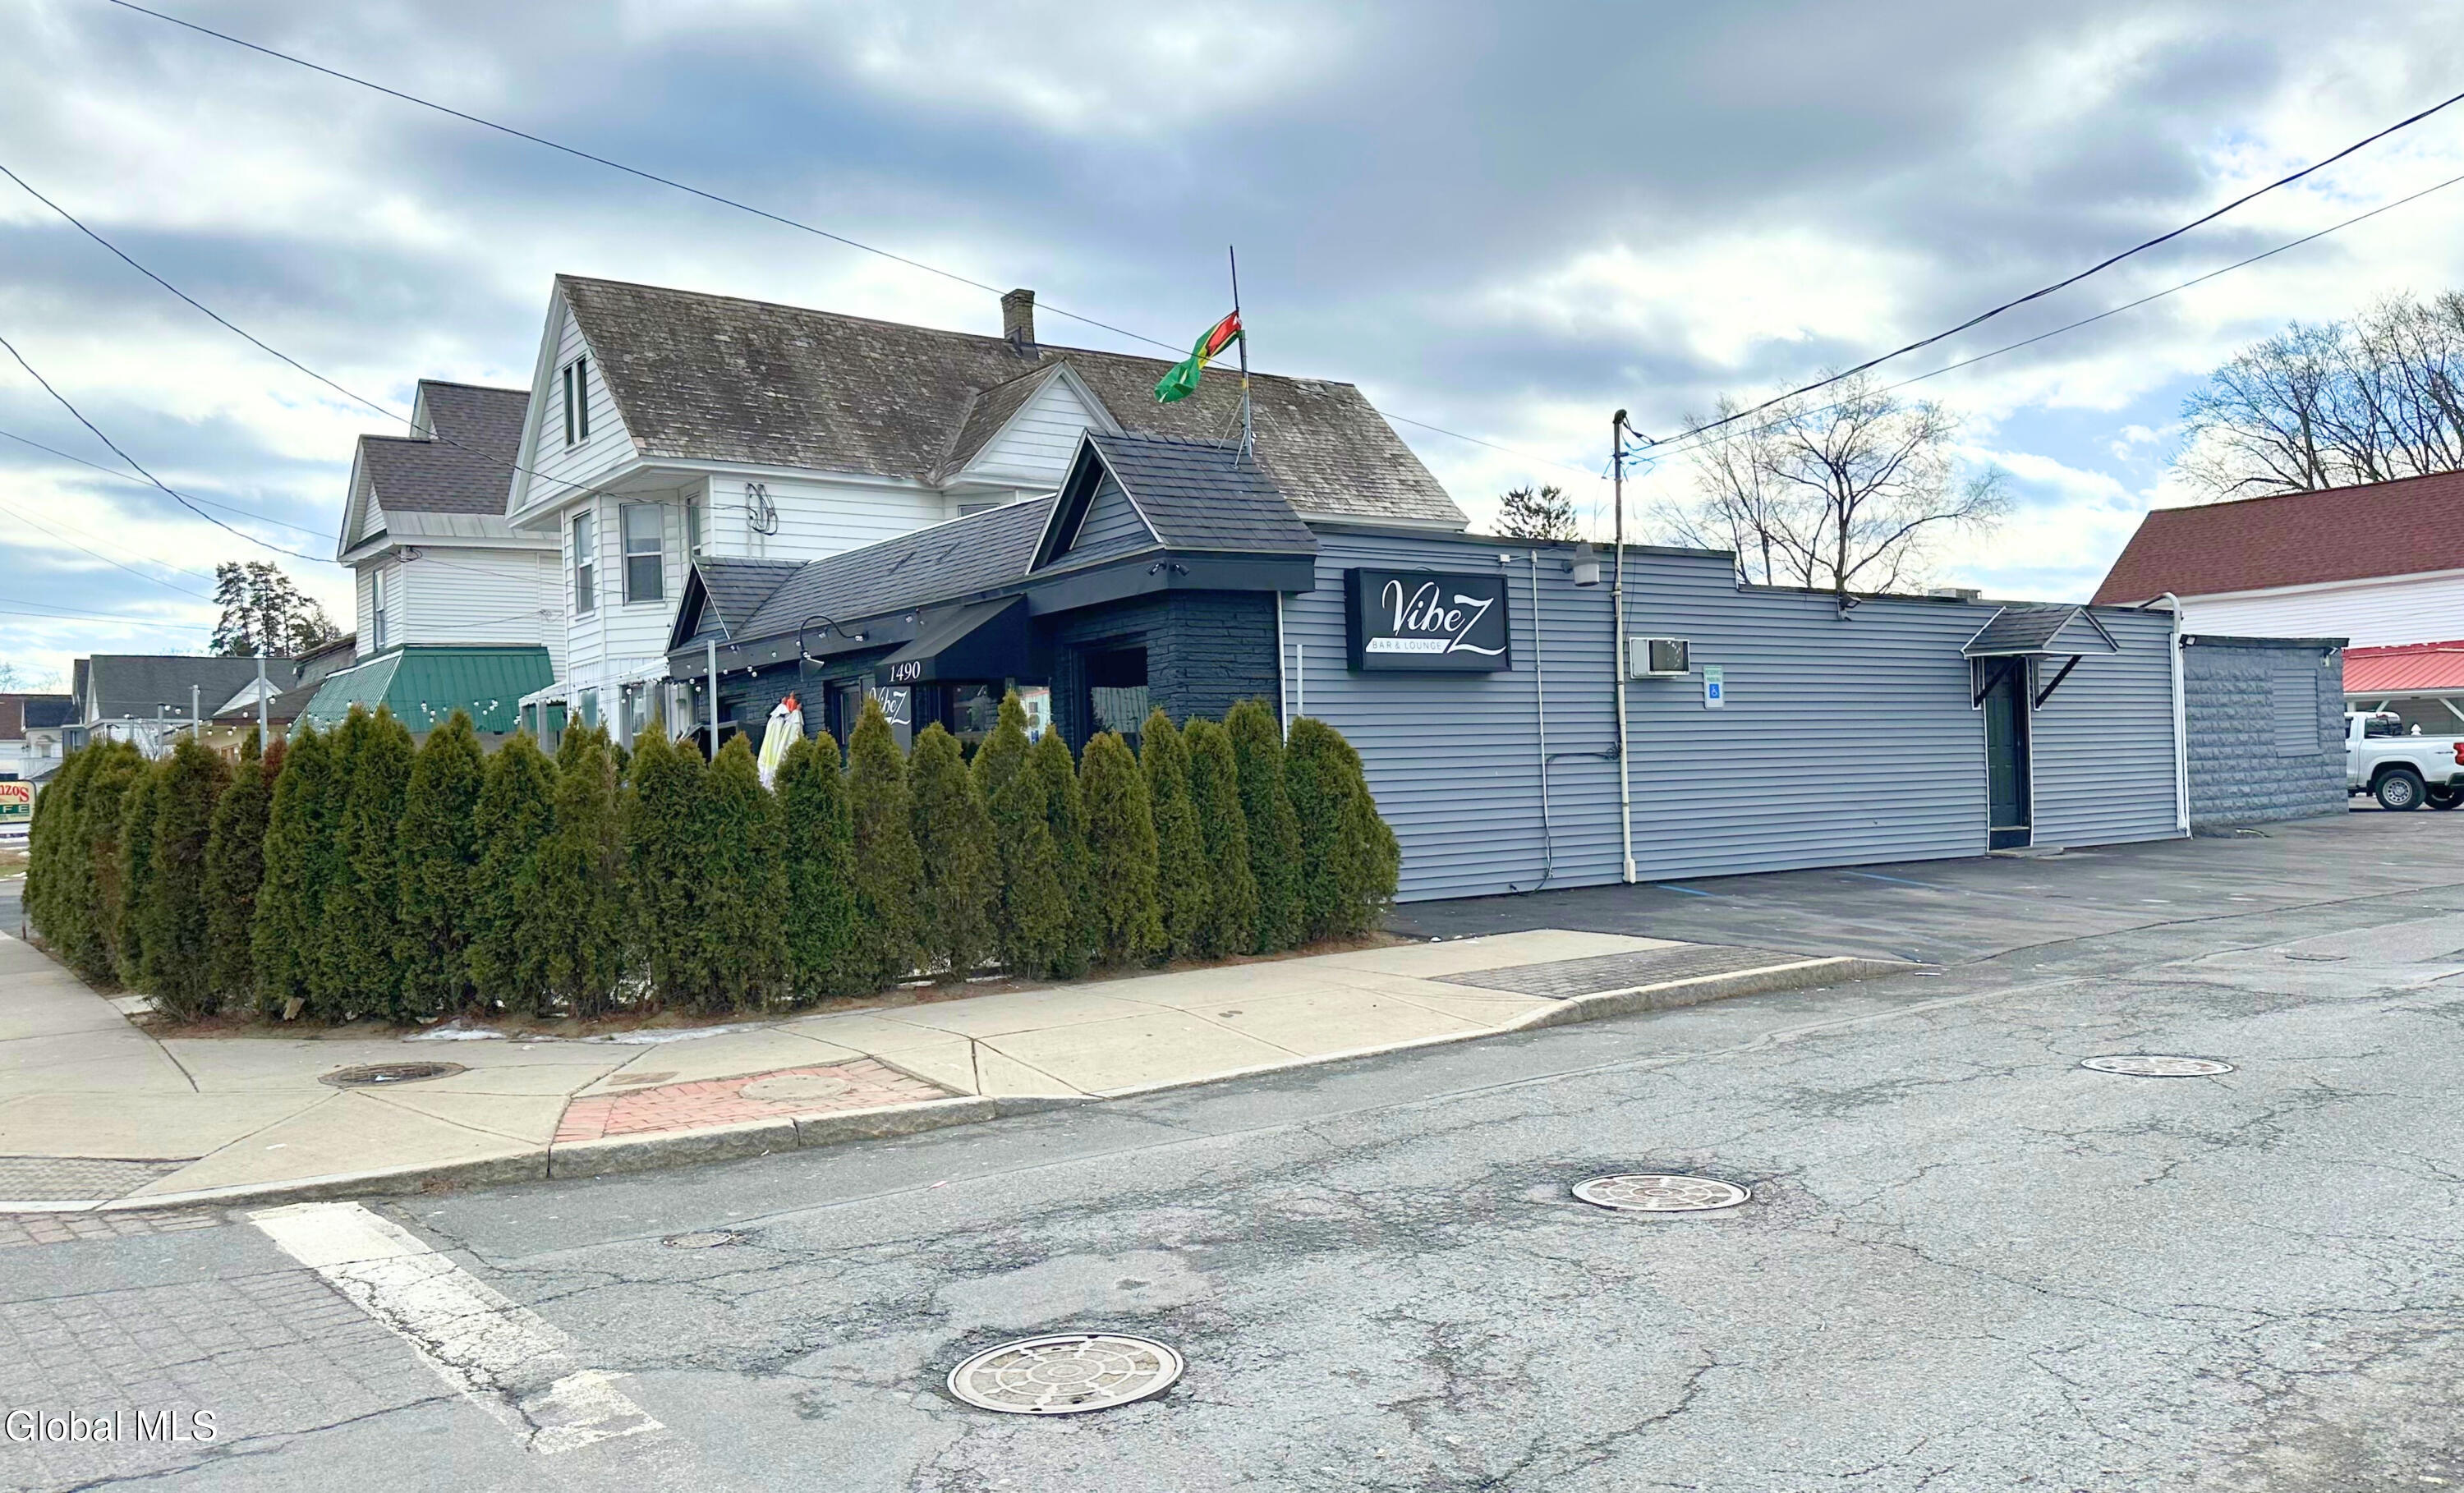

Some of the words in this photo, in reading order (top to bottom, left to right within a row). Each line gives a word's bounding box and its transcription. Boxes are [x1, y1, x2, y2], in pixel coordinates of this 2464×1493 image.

[1372, 641, 1391, 650] BAR
[1395, 641, 1400, 650] &
[1404, 641, 1441, 650] LOUNGE
[890, 660, 921, 682] 1490
